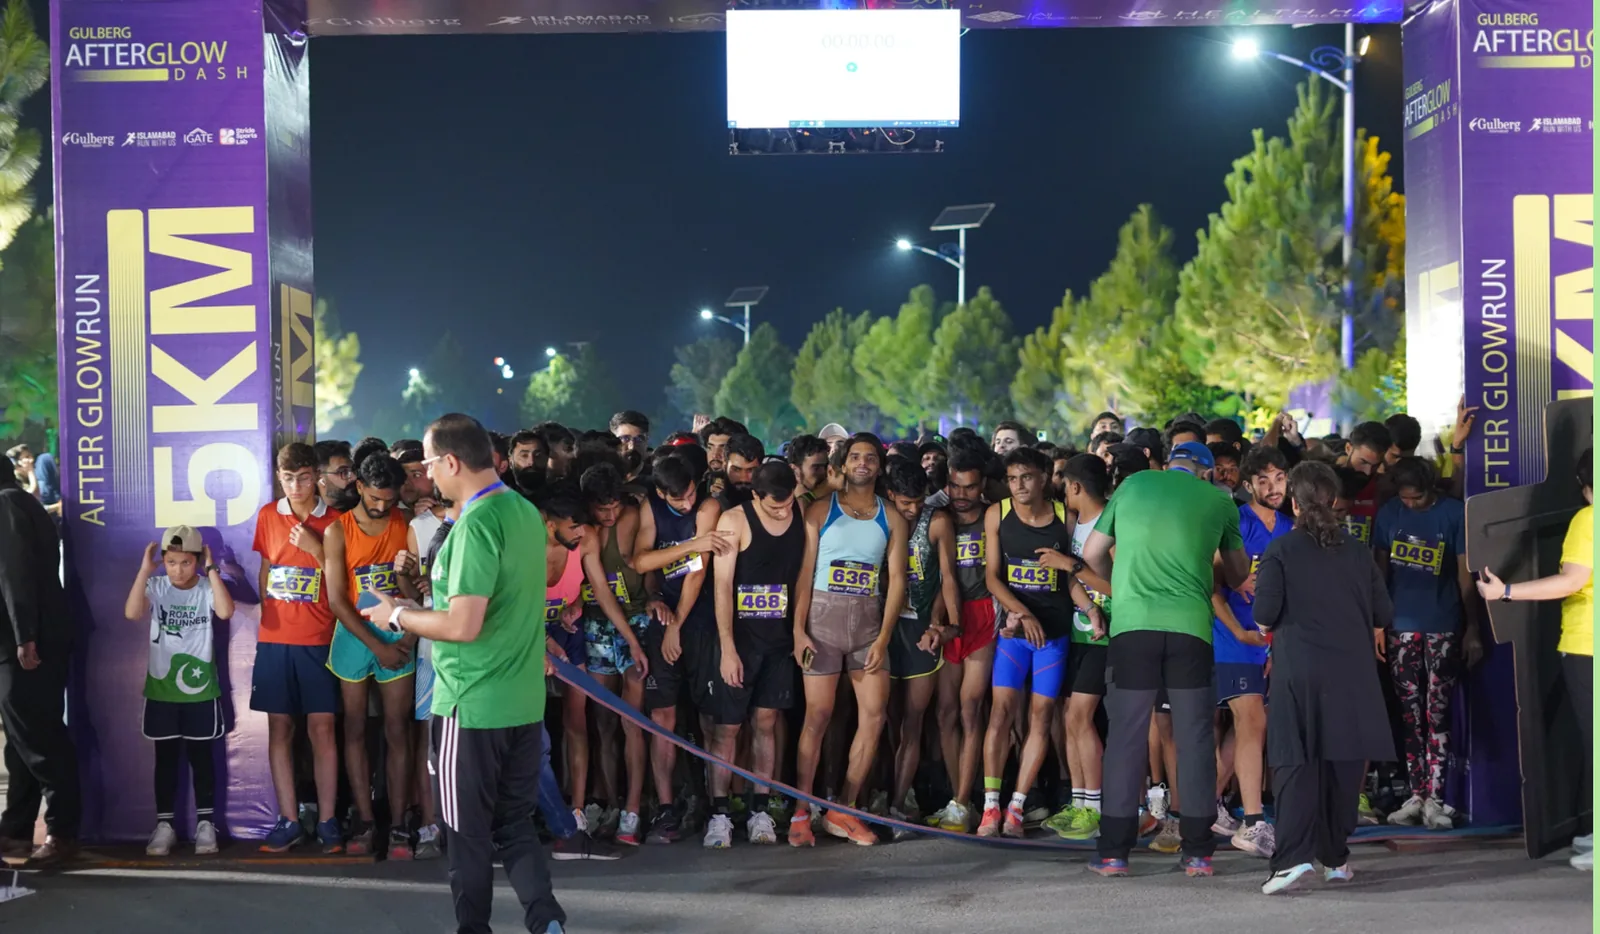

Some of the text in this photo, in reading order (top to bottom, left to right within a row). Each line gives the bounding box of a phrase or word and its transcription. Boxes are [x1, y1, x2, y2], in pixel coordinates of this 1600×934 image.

[530, 14, 651, 22] ISLAMABAD
[1477, 13, 1538, 26] GULBERG
[69, 26, 132, 40] GULBERG
[1473, 28, 1593, 52] AFTERGL
[65, 41, 228, 67] AFTERGLOW
[174, 66, 248, 81] DASH
[1404, 78, 1451, 128] AFTERGLOW
[1476, 117, 1521, 132] Gulberg
[1542, 117, 1582, 125] ISLAMABAD
[136, 131, 176, 139] ISLAMABAD
[1542, 125, 1556, 133] RUN
[1556, 125, 1572, 133] WITH
[1573, 125, 1582, 133] US
[70, 132, 115, 147] Gulberg
[136, 139, 177, 147] RUN WITH US
[183, 132, 214, 144] IGATE
[148, 206, 261, 528] 5KM
[1481, 258, 1510, 488] FTER GLOWRUN
[75, 274, 105, 527] AFTER GLOWRUN
[957, 542, 980, 558] 79
[1395, 543, 1434, 563] 049
[359, 572, 398, 590] 524
[832, 568, 871, 586] 636
[1011, 567, 1050, 583] 443
[741, 594, 780, 609] 468
[169, 610, 196, 618] ROAD
